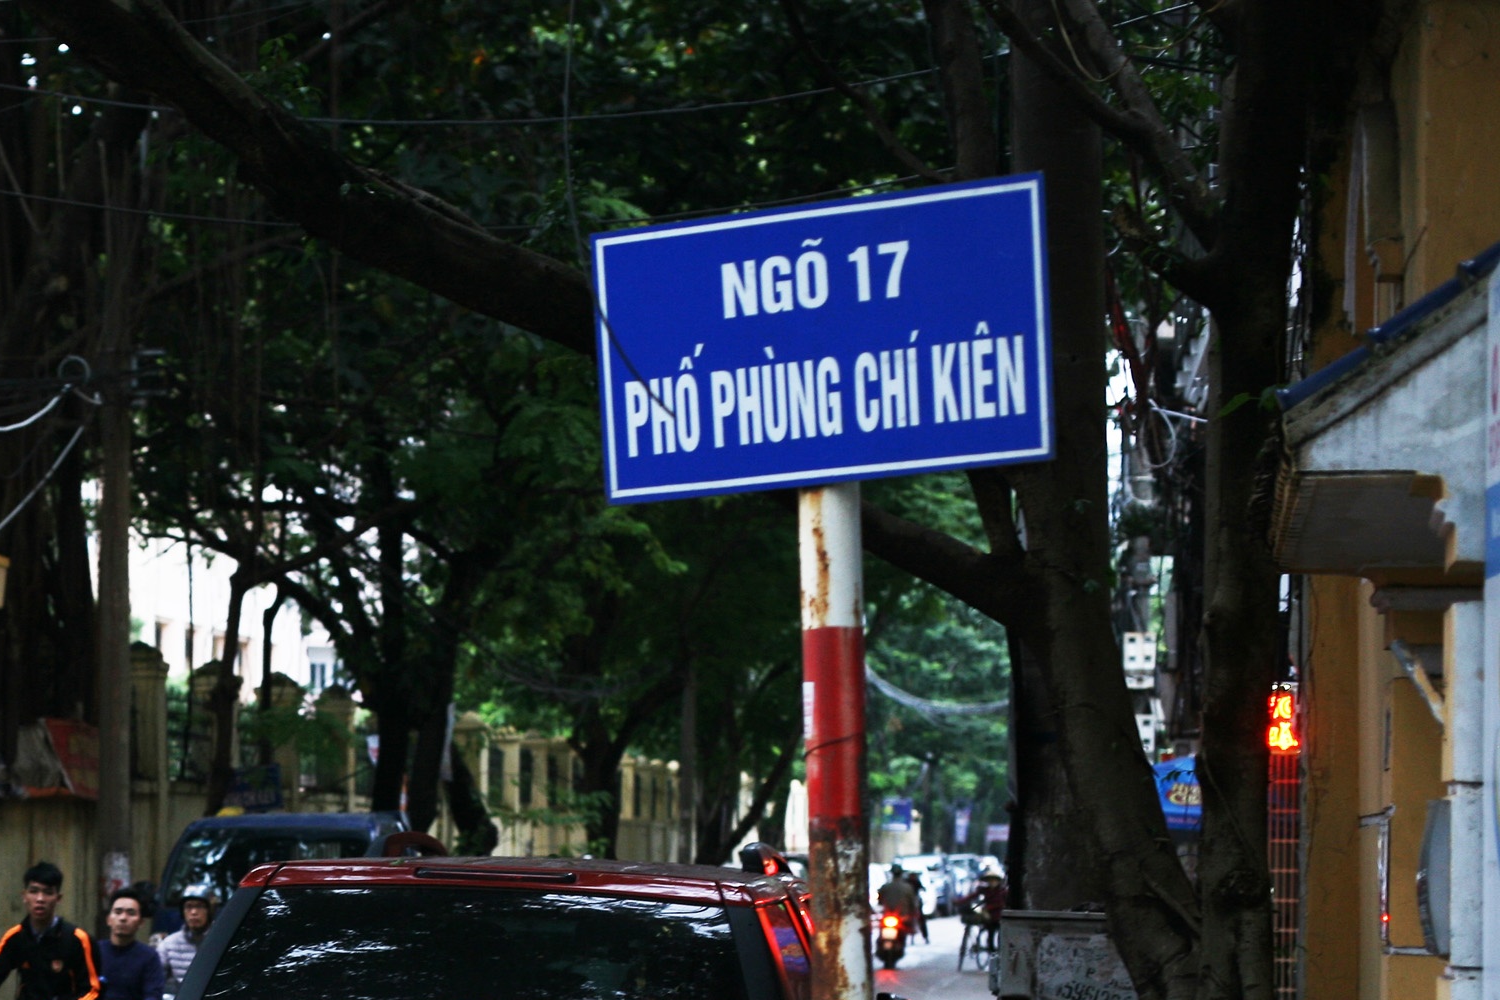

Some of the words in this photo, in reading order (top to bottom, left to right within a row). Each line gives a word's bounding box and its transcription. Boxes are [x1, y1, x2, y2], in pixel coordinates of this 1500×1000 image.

[720, 238, 830, 320] NGÕ
[847, 240, 911, 303] 17
[623, 343, 705, 459] PHỐ
[709, 346, 844, 449] PHÙNG
[853, 329, 921, 434] CHÍ
[930, 320, 1027, 425] KIÊN
